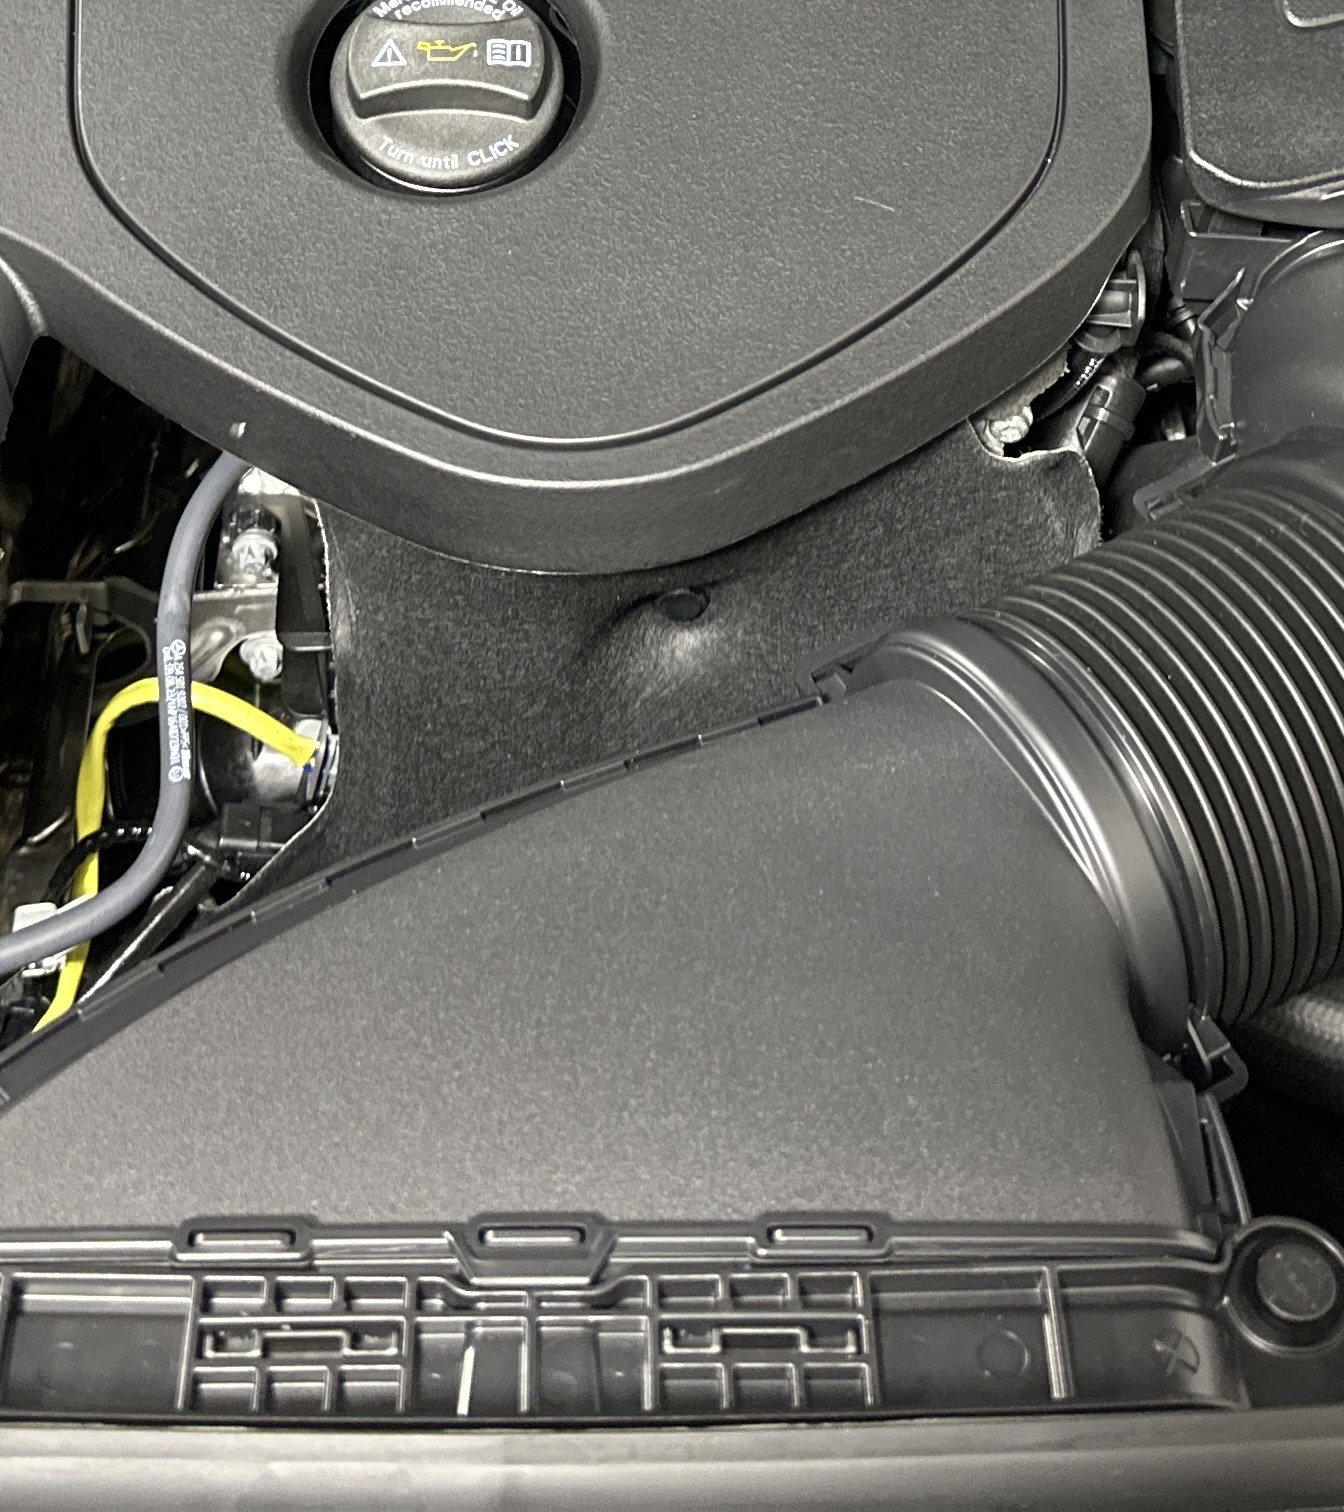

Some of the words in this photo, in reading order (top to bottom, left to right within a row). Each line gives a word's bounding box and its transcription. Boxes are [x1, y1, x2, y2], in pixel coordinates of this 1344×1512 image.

[502, 0, 525, 18] Oil
[378, 135, 415, 165] Turn
[422, 153, 459, 170] until
[467, 134, 520, 167] CLICK
